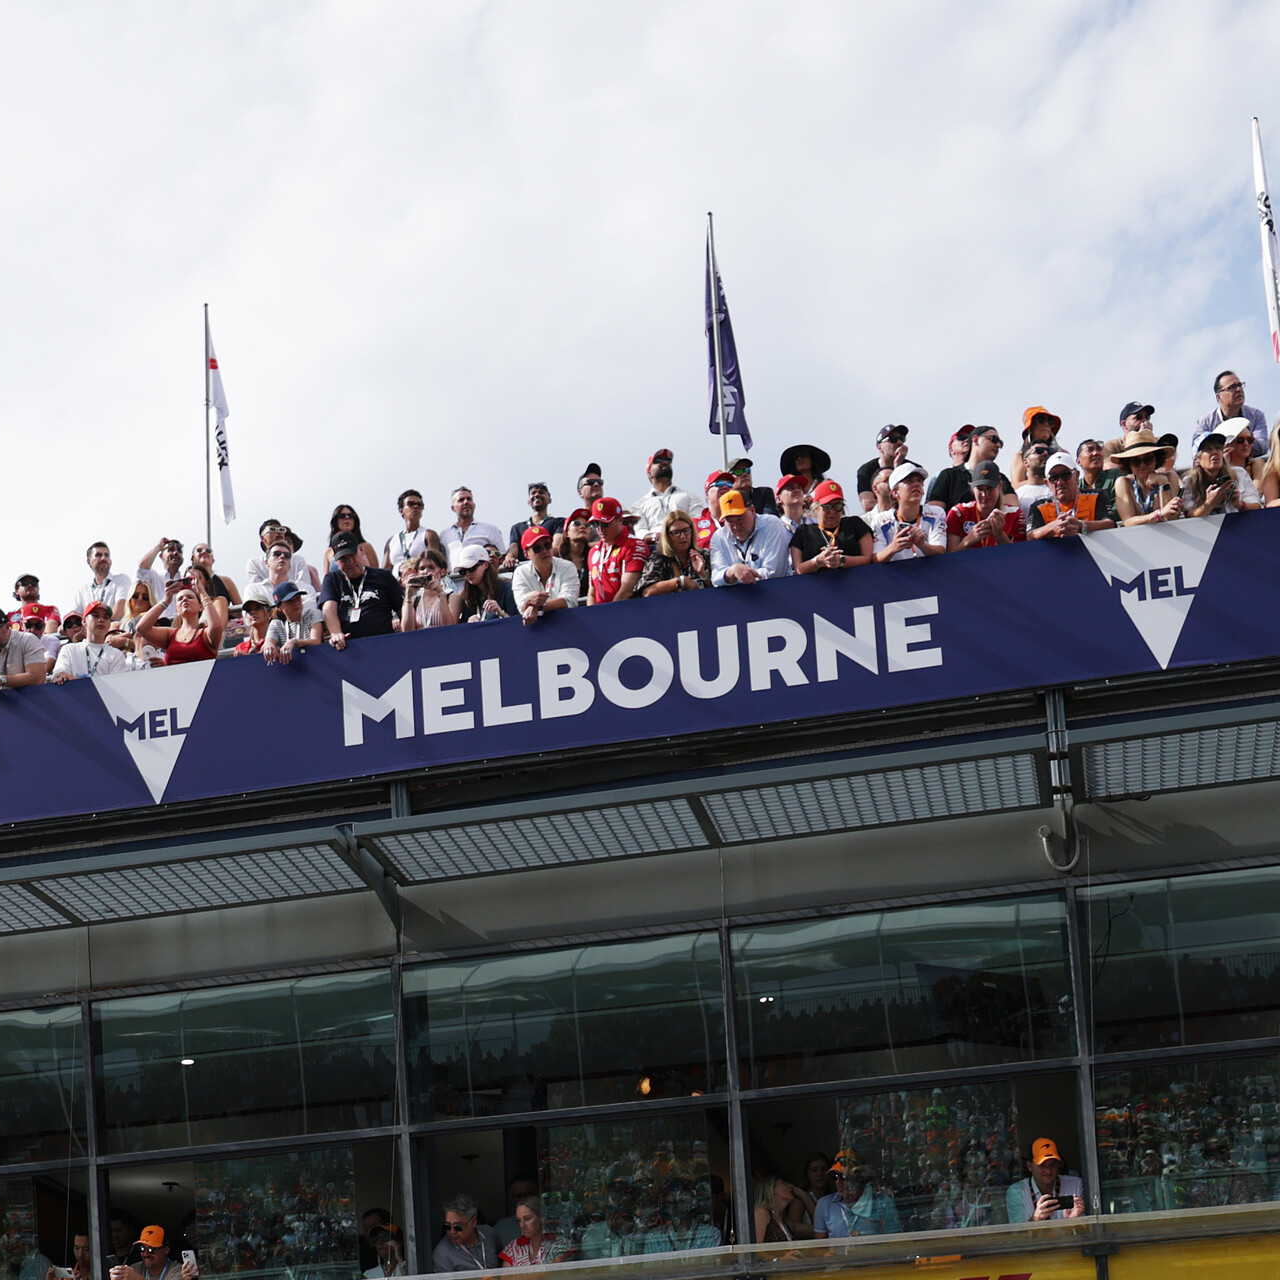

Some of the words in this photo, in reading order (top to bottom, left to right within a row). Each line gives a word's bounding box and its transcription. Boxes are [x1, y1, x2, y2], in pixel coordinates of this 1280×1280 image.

[1111, 567, 1198, 603] MEL
[341, 595, 944, 748] MELBOURNE
[116, 707, 193, 741] MEL
